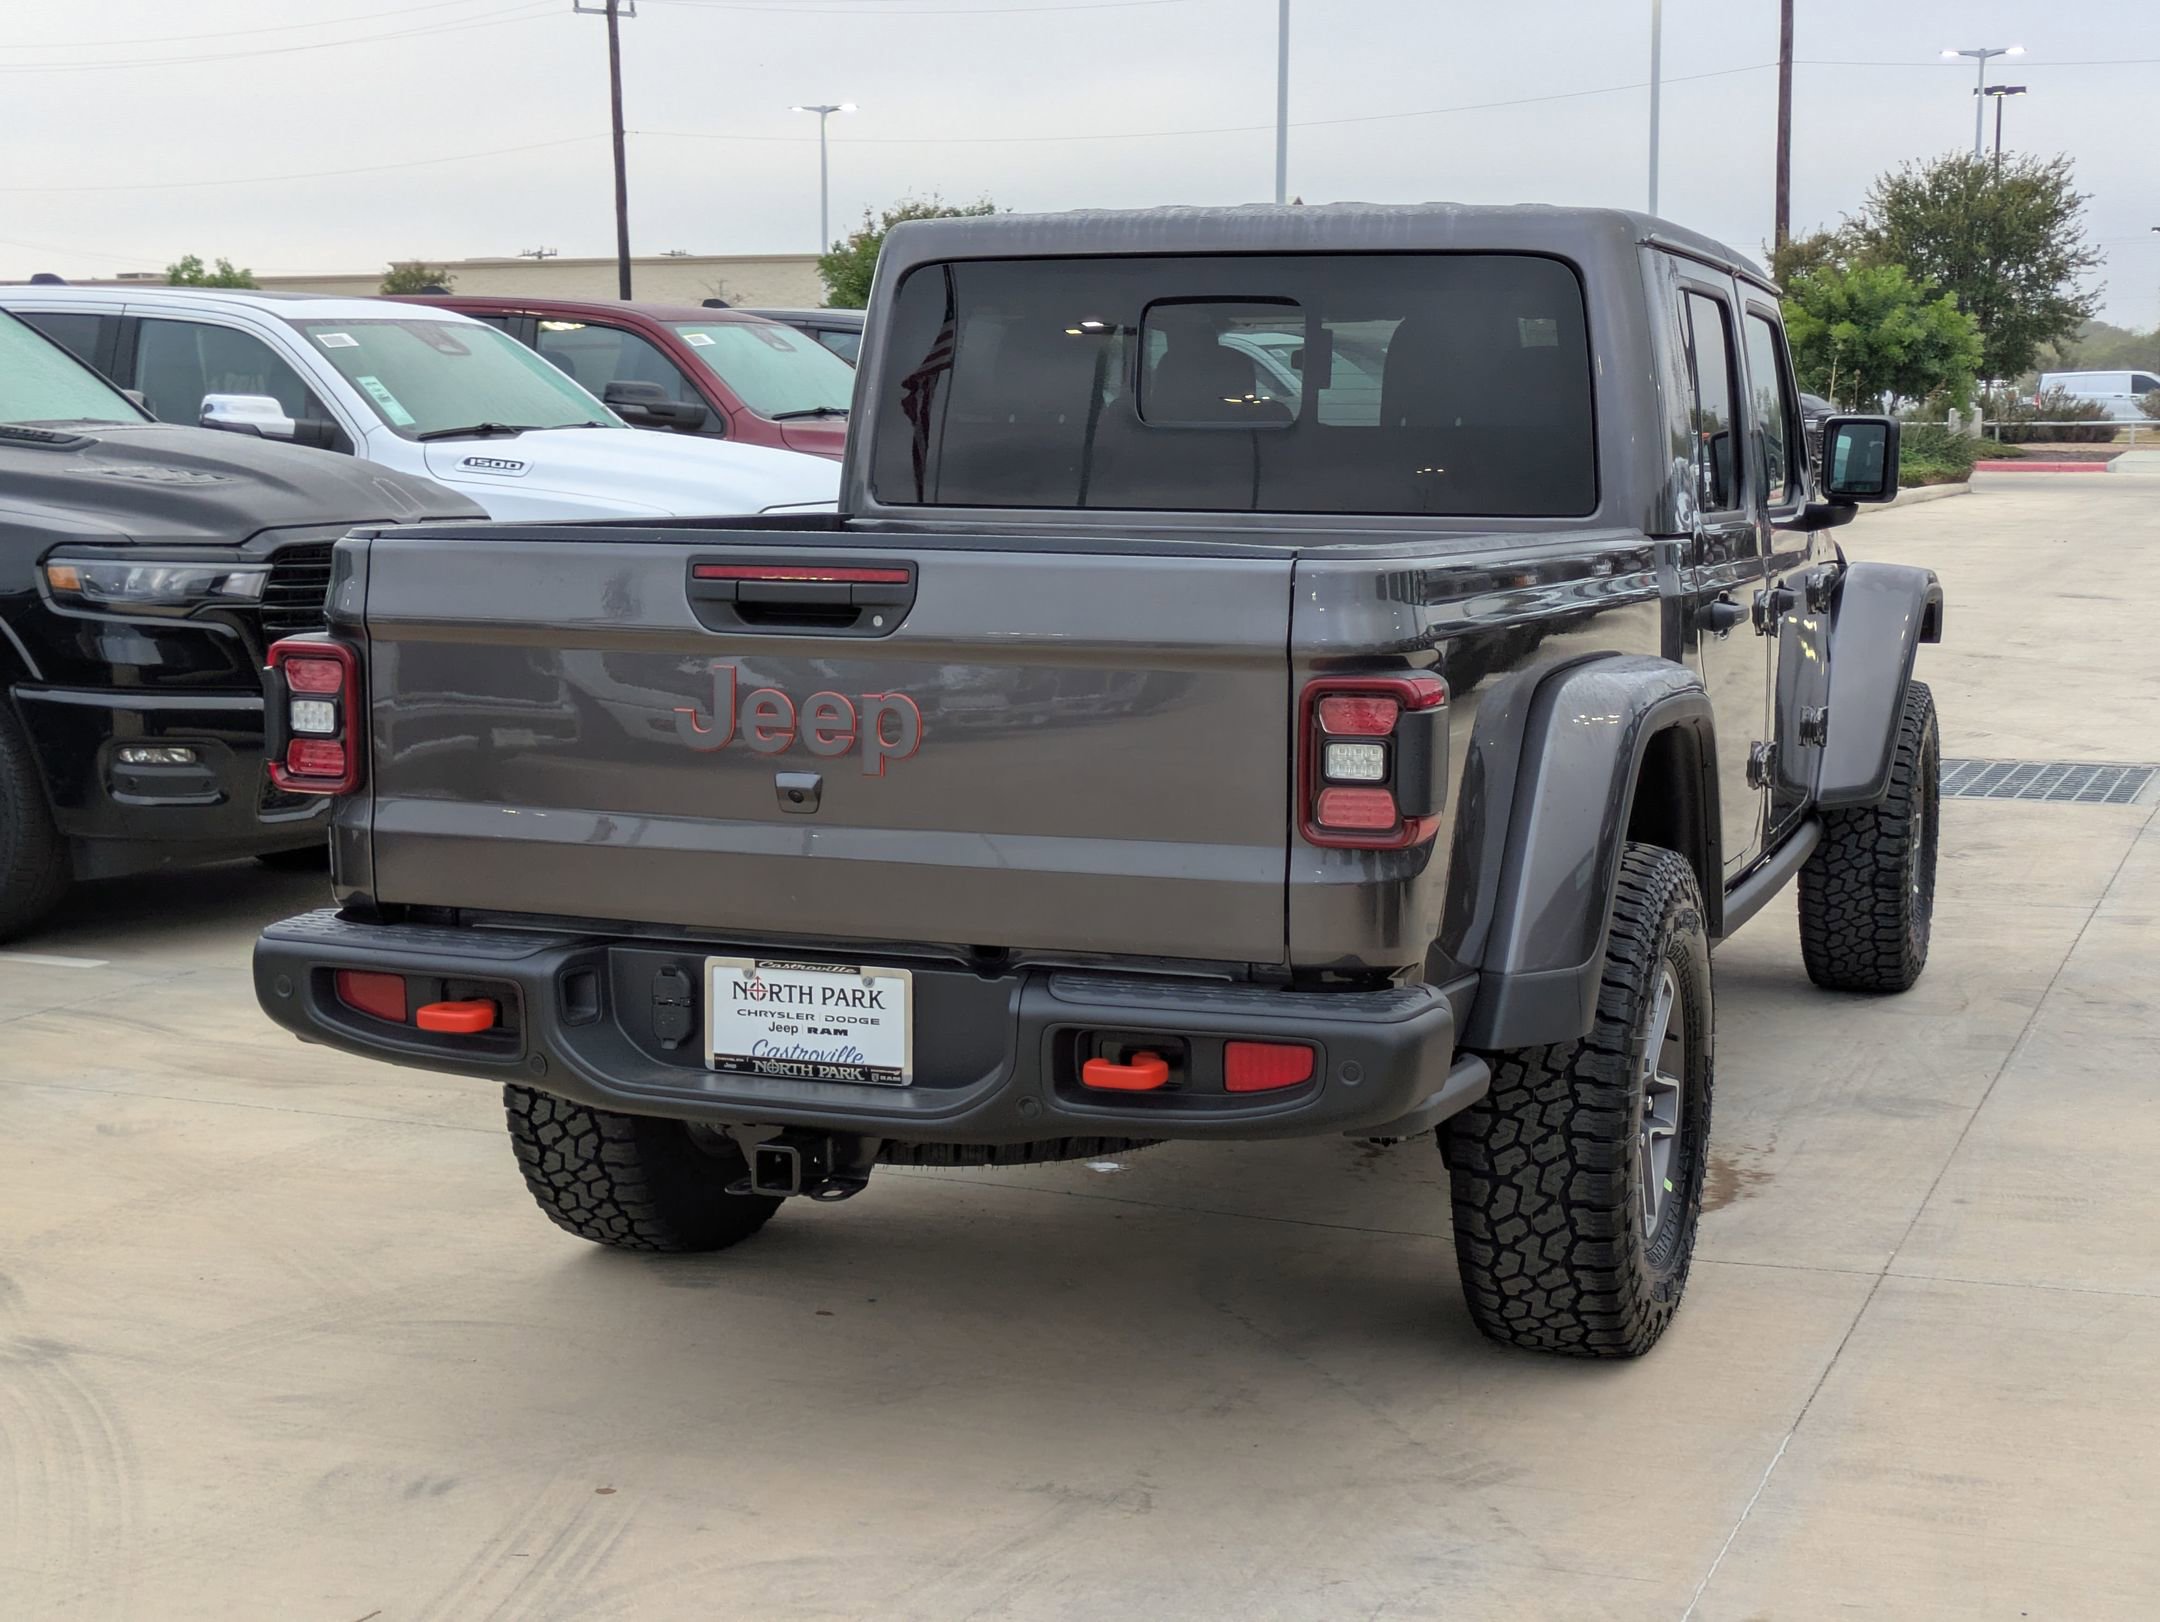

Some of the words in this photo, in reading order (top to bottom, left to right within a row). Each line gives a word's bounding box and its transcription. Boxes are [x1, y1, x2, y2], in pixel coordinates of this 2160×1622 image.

[469, 458, 521, 470] 1500
[673, 664, 923, 777] Jeep
[758, 960, 857, 974] Castroville
[732, 978, 814, 1005] NORTH
[821, 987, 887, 1010] PARK
[736, 1008, 815, 1021] CHRYSLER
[824, 1015, 881, 1025] DODGE
[768, 1021, 799, 1036] Jeep
[807, 1026, 848, 1036] RAM
[751, 1038, 865, 1064] Castroville
[752, 1058, 814, 1077] NORTH
[816, 1065, 865, 1081] PARK
